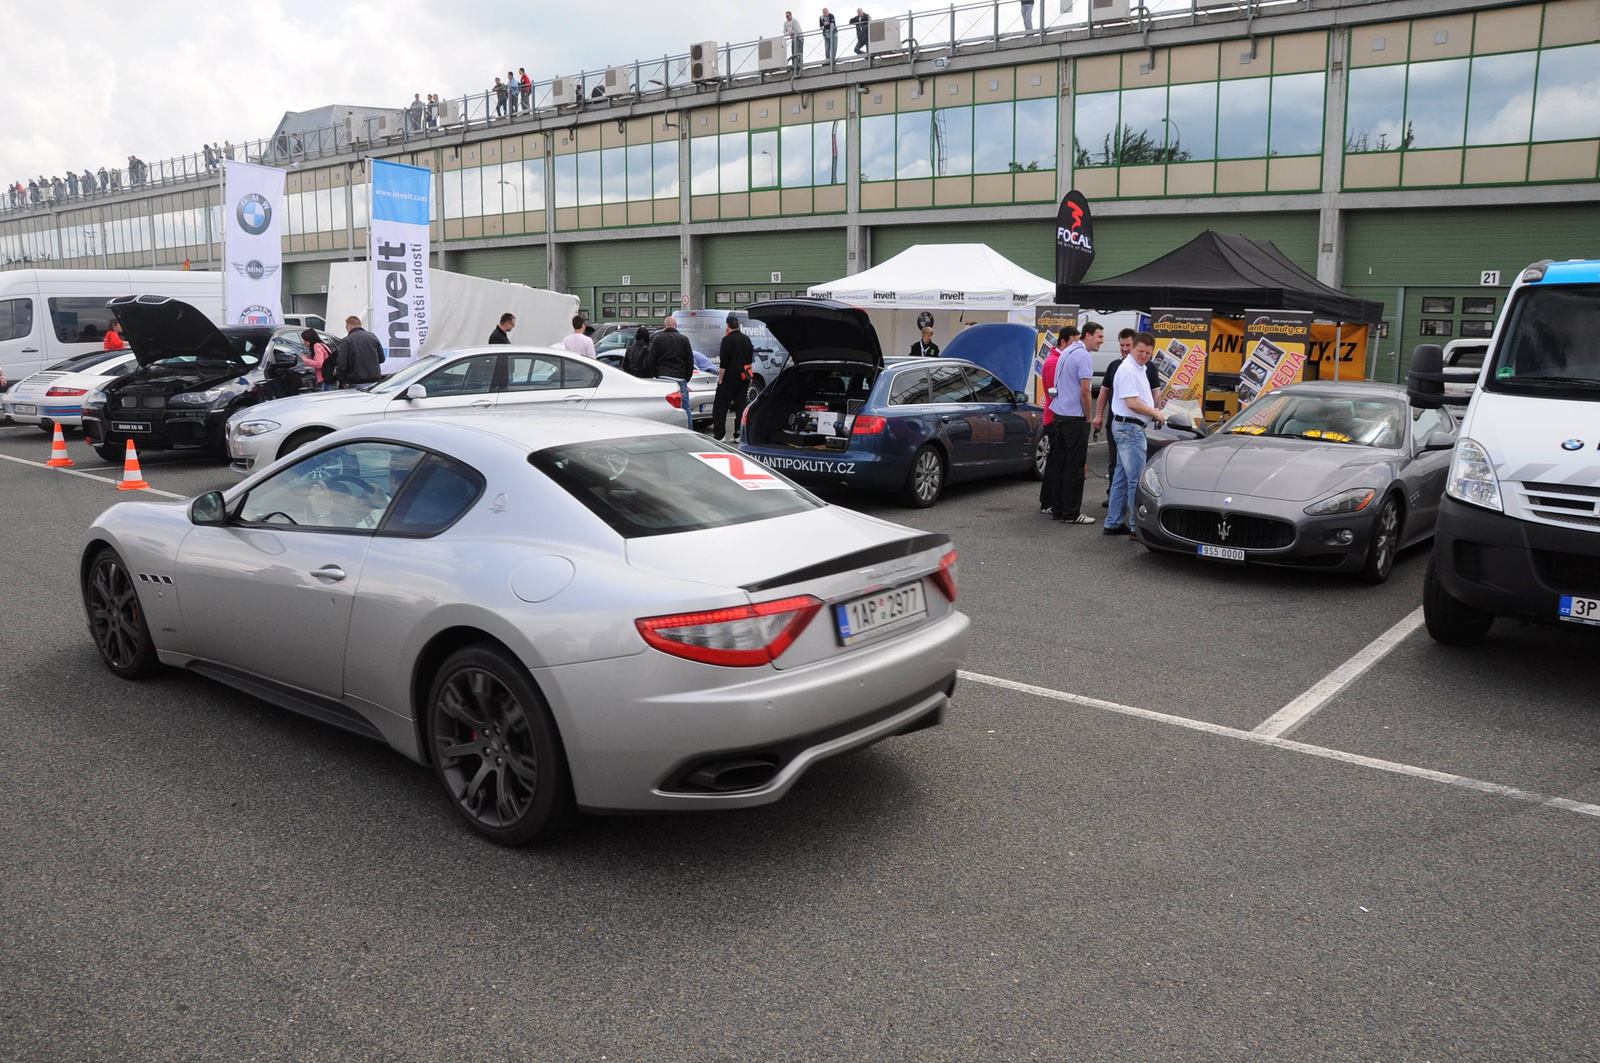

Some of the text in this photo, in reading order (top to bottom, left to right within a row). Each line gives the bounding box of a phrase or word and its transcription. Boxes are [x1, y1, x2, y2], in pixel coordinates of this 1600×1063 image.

[241, 194, 270, 210] BMW
[375, 190, 427, 202] www.invelt.com
[1057, 227, 1092, 250] FOCAL
[247, 266, 263, 275] MINI
[410, 243, 424, 289] radostí
[623, 276, 629, 284] 17
[772, 273, 780, 282] 18
[1483, 272, 1496, 284] 21
[377, 241, 411, 358] invelt
[811, 291, 833, 300] invelt
[873, 290, 896, 300] invelt
[940, 291, 964, 300] invelt
[740, 324, 767, 336] invelt
[1154, 321, 1208, 333] antipokuty.cz
[1248, 323, 1307, 336] antipokuty.cz
[1203, 546, 1243, 560] 9S5 0000
[852, 587, 916, 630] 1AP 2977
[1575, 600, 1598, 616] 3P
